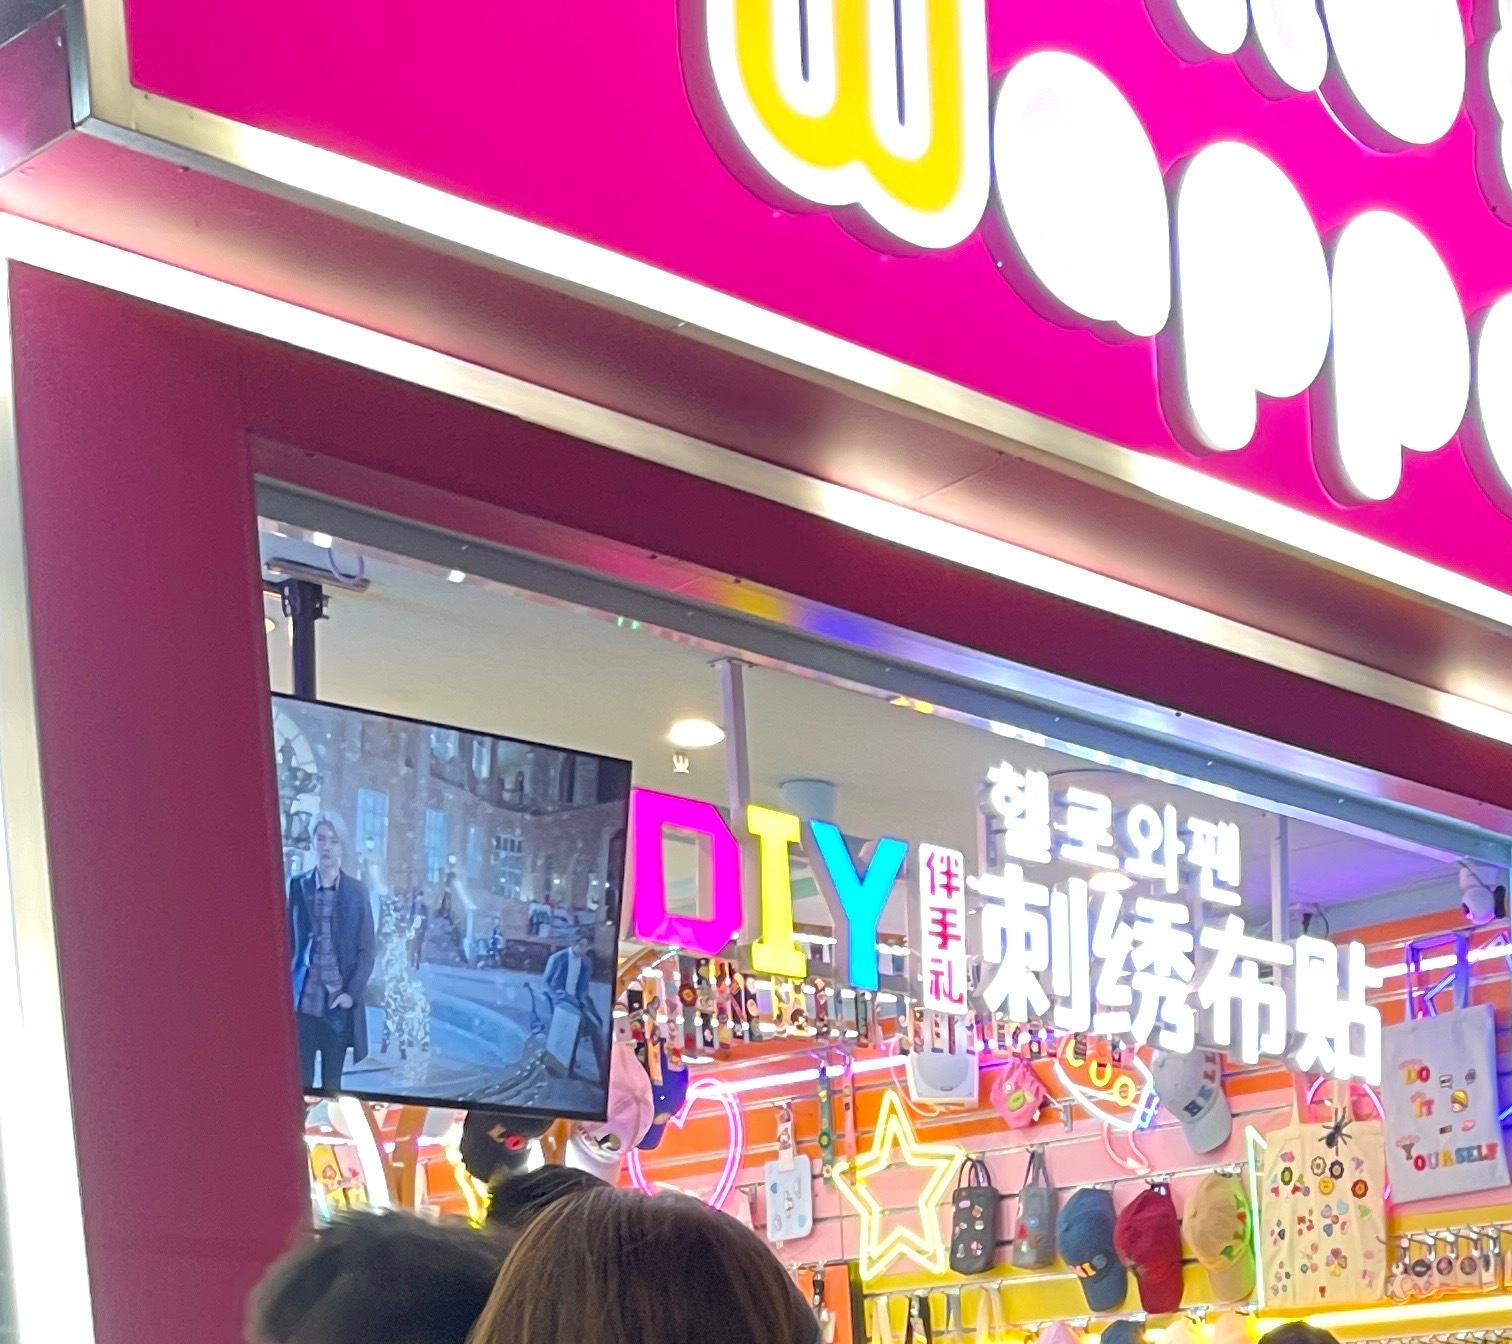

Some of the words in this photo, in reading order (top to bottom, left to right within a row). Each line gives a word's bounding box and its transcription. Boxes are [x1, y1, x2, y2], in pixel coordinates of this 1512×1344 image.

[632, 788, 909, 992] DIY
[926, 851, 965, 1005] 伴手礼
[965, 862, 1384, 1086] 刺绣布贴
